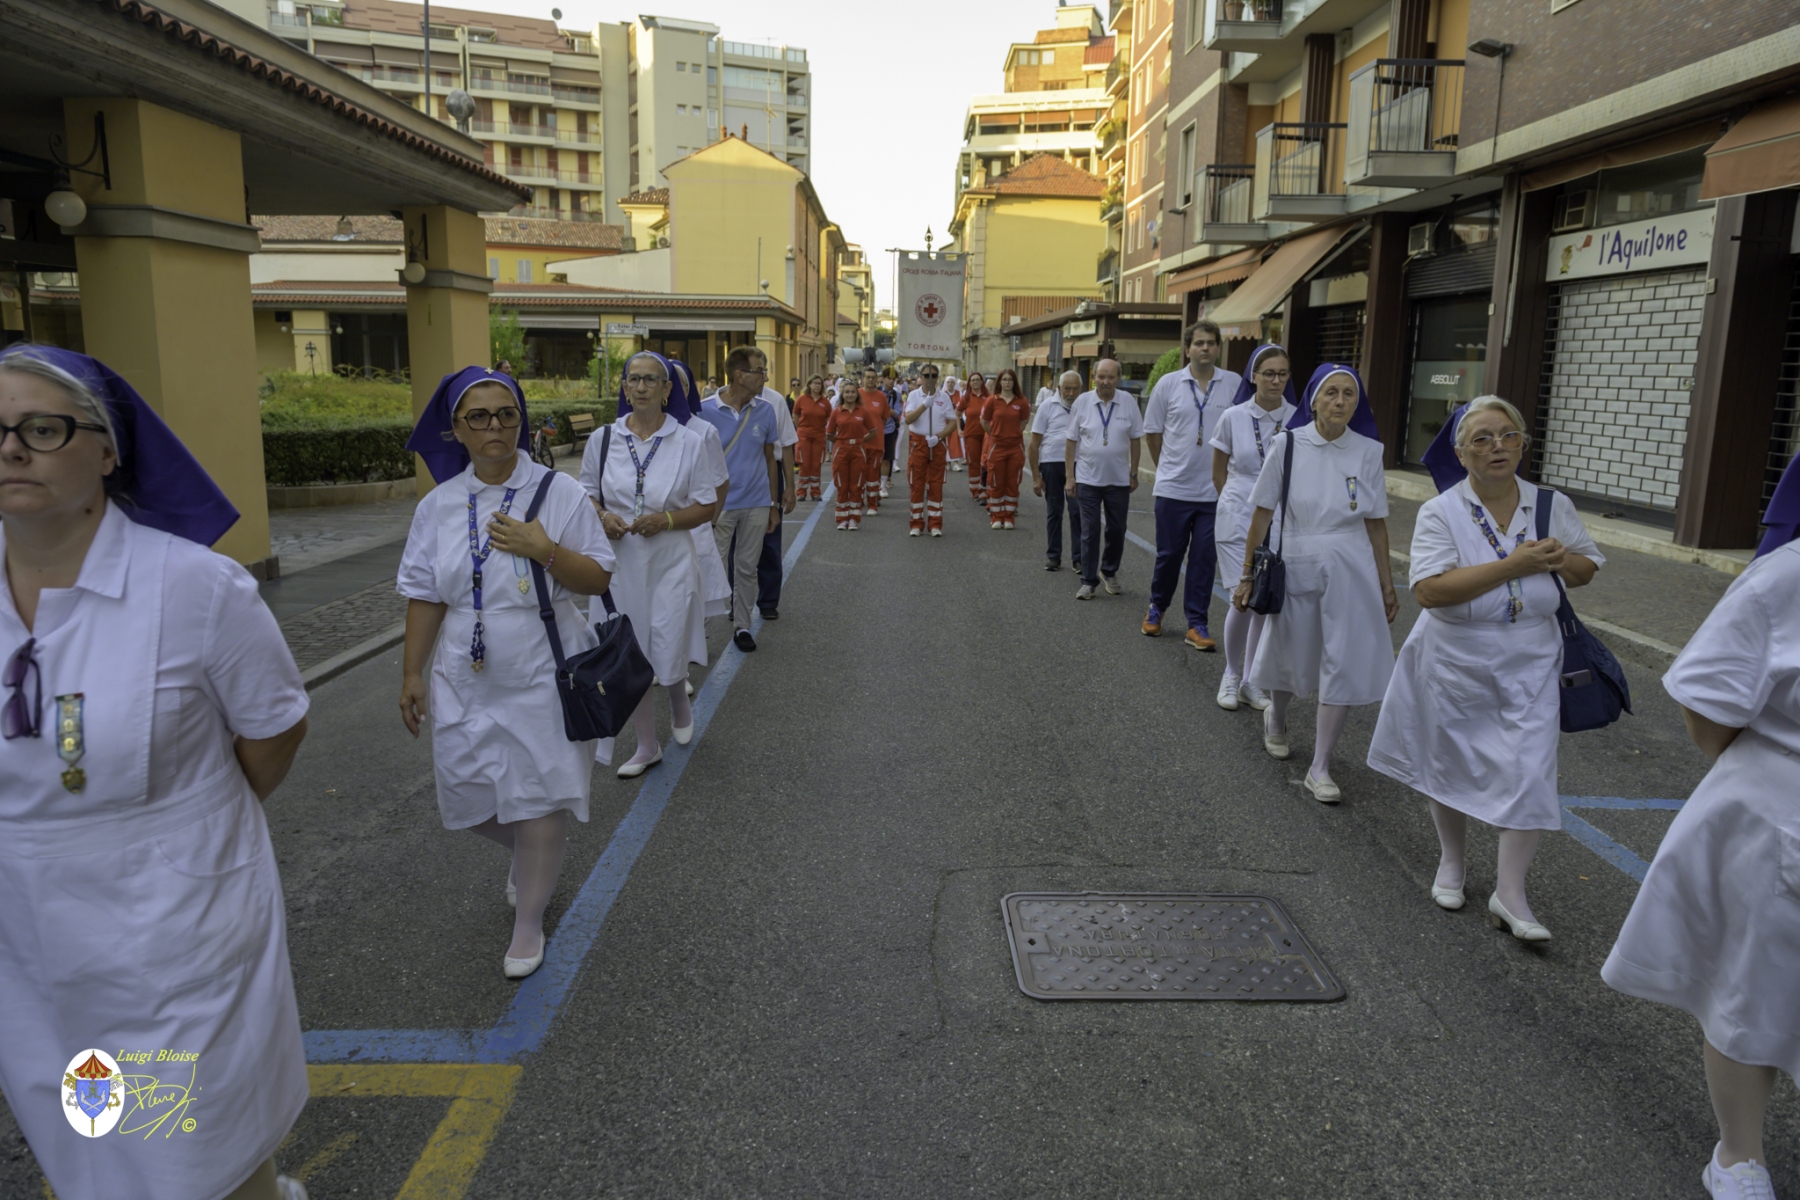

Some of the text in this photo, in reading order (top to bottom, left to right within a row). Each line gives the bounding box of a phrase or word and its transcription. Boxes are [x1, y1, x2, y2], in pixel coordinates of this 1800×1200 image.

[1598, 225, 1688, 270] l'Aquilone
[908, 343, 950, 352] TORTONA
[1430, 374, 1460, 385] ABSOLUT
[1051, 945, 1174, 958] TORTONA
